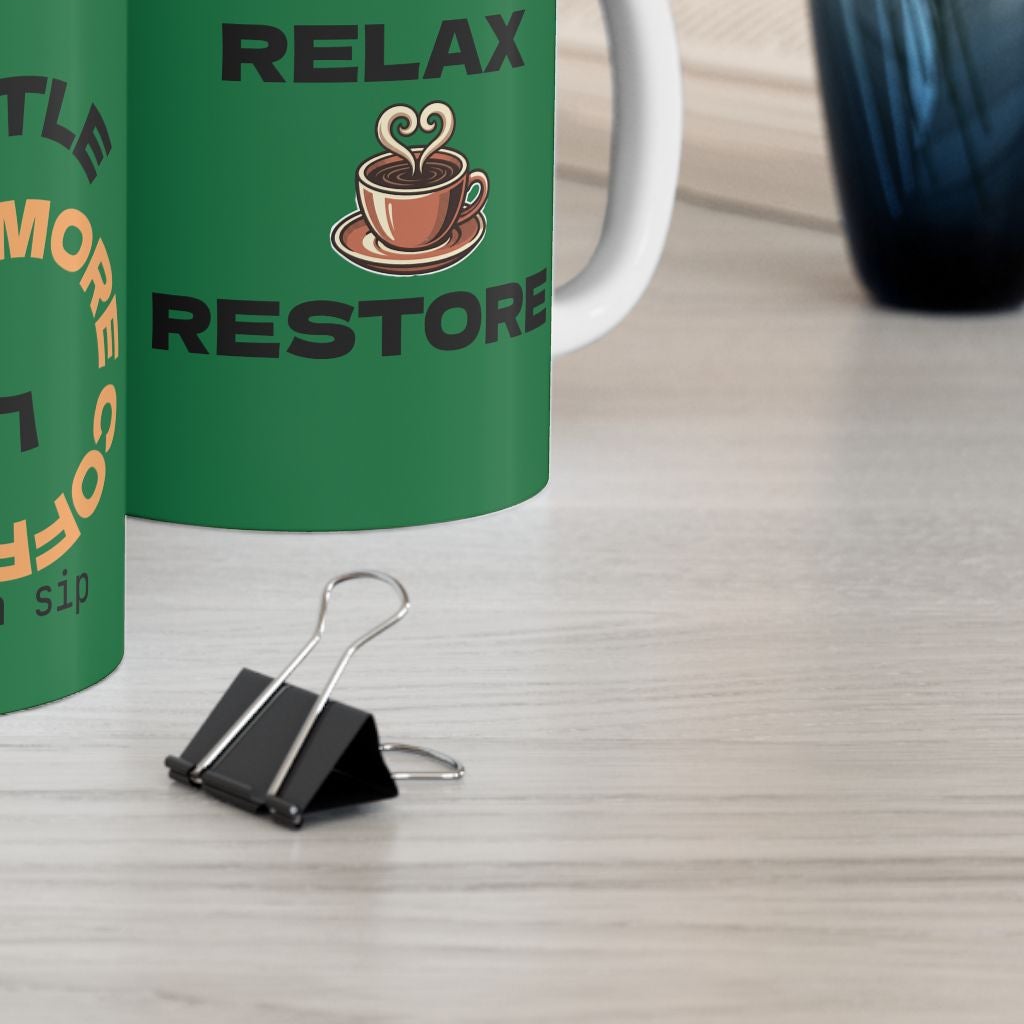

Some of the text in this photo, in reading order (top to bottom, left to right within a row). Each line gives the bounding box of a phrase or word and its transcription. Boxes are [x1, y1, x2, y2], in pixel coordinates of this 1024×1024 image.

[221, 9, 526, 83] RELAX
[151, 267, 548, 360] RESTORE
[34, 568, 90, 617] sip
